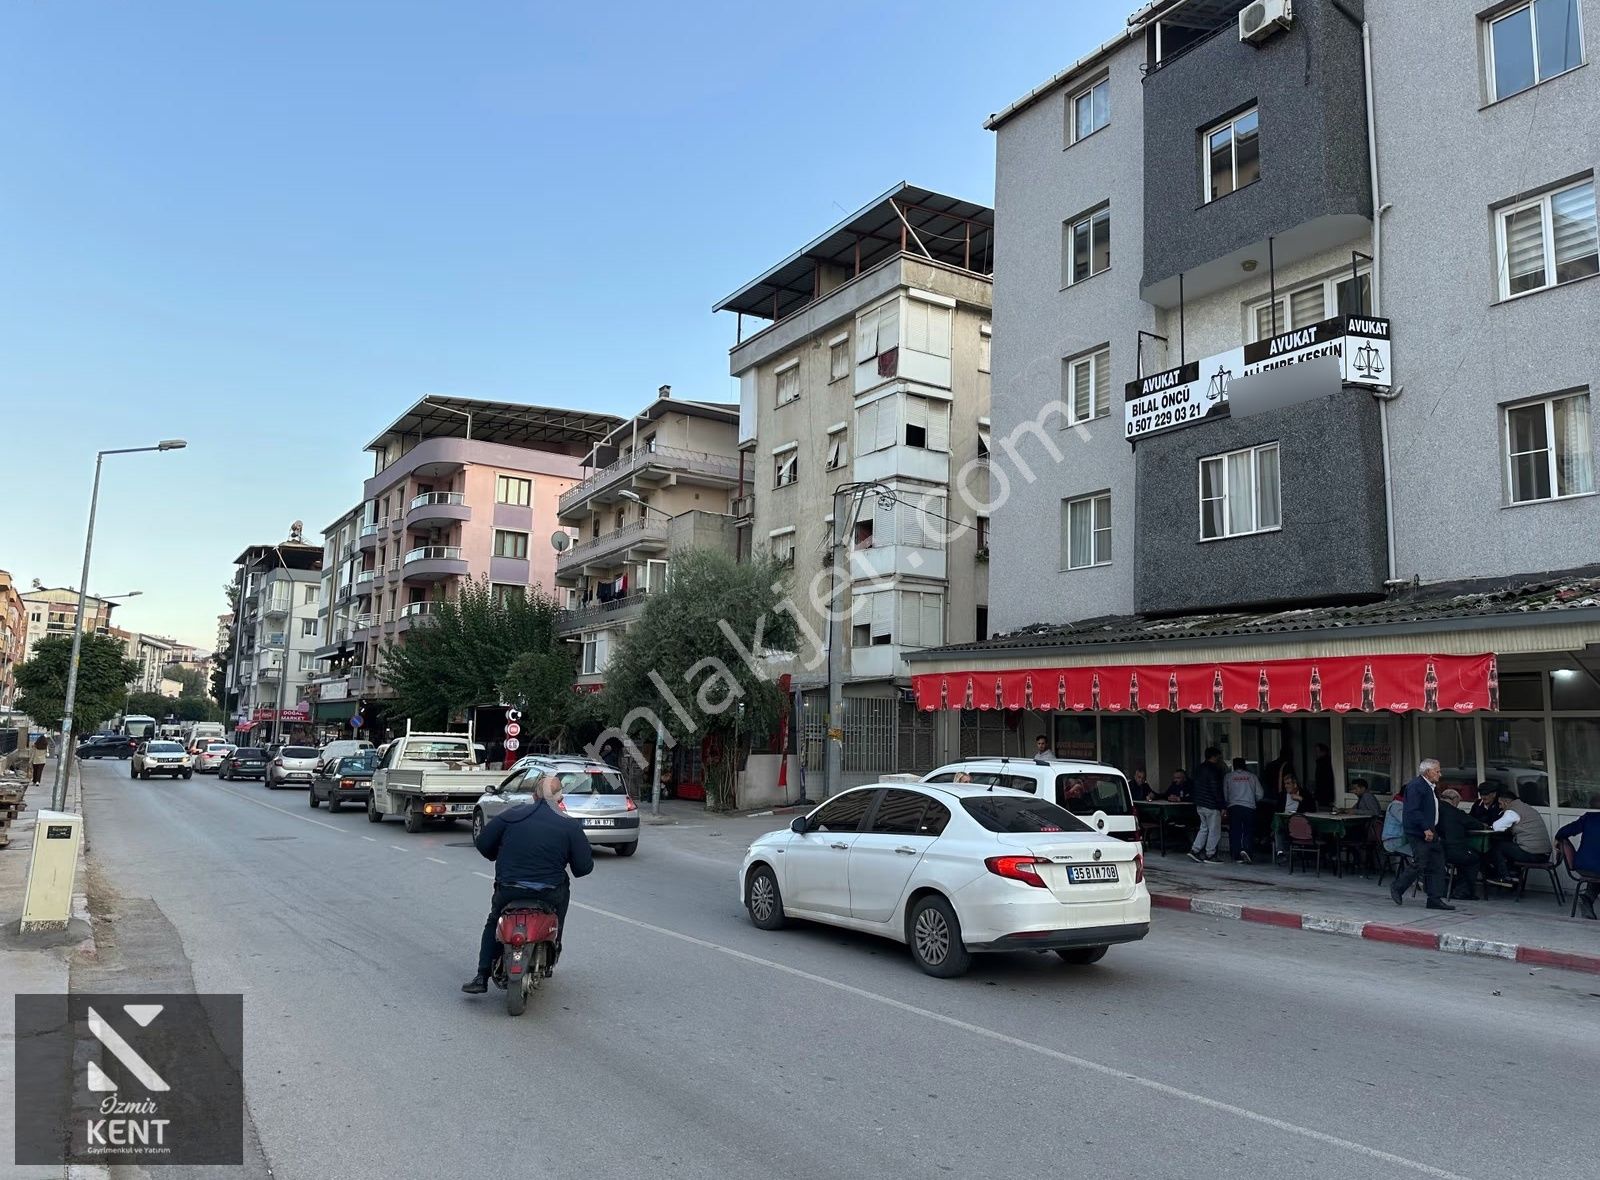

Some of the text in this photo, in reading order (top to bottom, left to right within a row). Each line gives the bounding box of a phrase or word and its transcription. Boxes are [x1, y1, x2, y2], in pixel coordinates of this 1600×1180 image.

[1348, 318, 1388, 336] AVUKAT
[1269, 326, 1317, 356] AVUKAT
[1142, 369, 1180, 394] AVUKAT
[1132, 384, 1190, 418] BİLAL ÖNCÜ
[1127, 402, 1201, 435] 0 507 229 03 21
[1073, 867, 1085, 879] 35
[1101, 866, 1116, 878] 708
